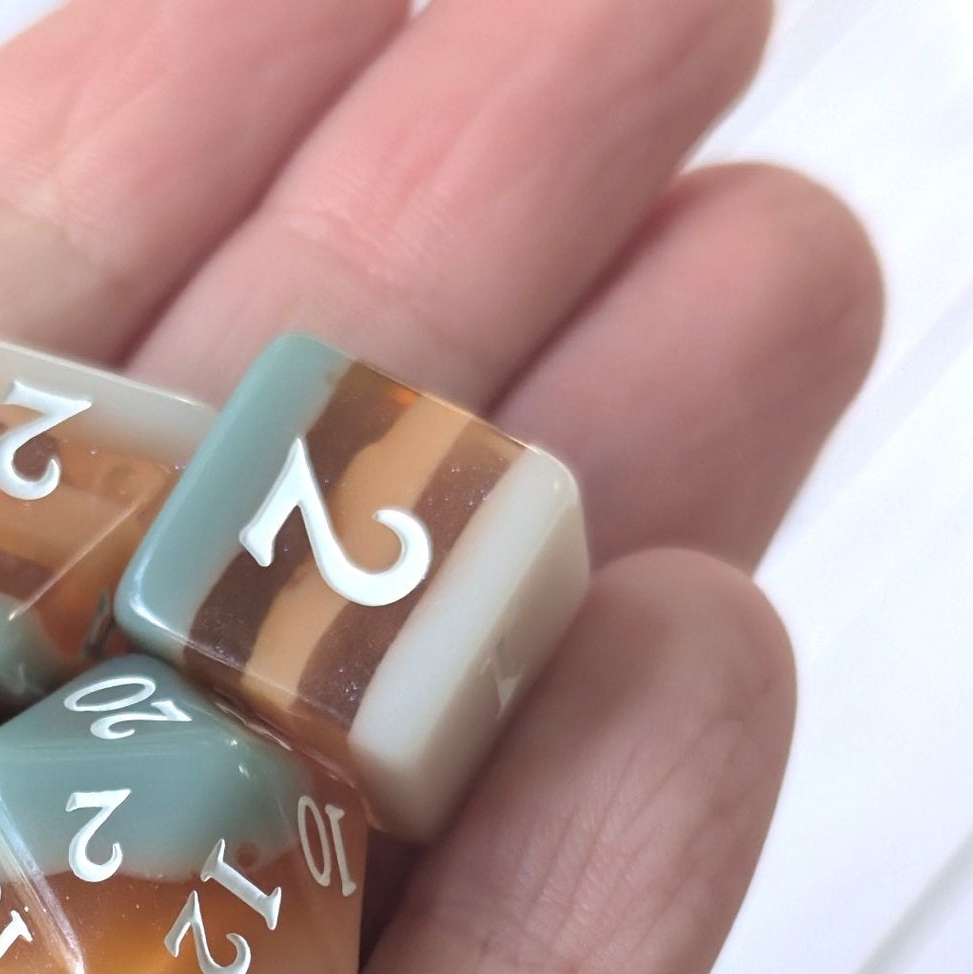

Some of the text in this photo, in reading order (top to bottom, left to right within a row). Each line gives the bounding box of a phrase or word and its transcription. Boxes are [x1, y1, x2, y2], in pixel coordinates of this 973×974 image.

[238, 437, 434, 607] 2
[63, 675, 192, 740] 20
[65, 788, 131, 882] 2
[297, 795, 356, 896] 10
